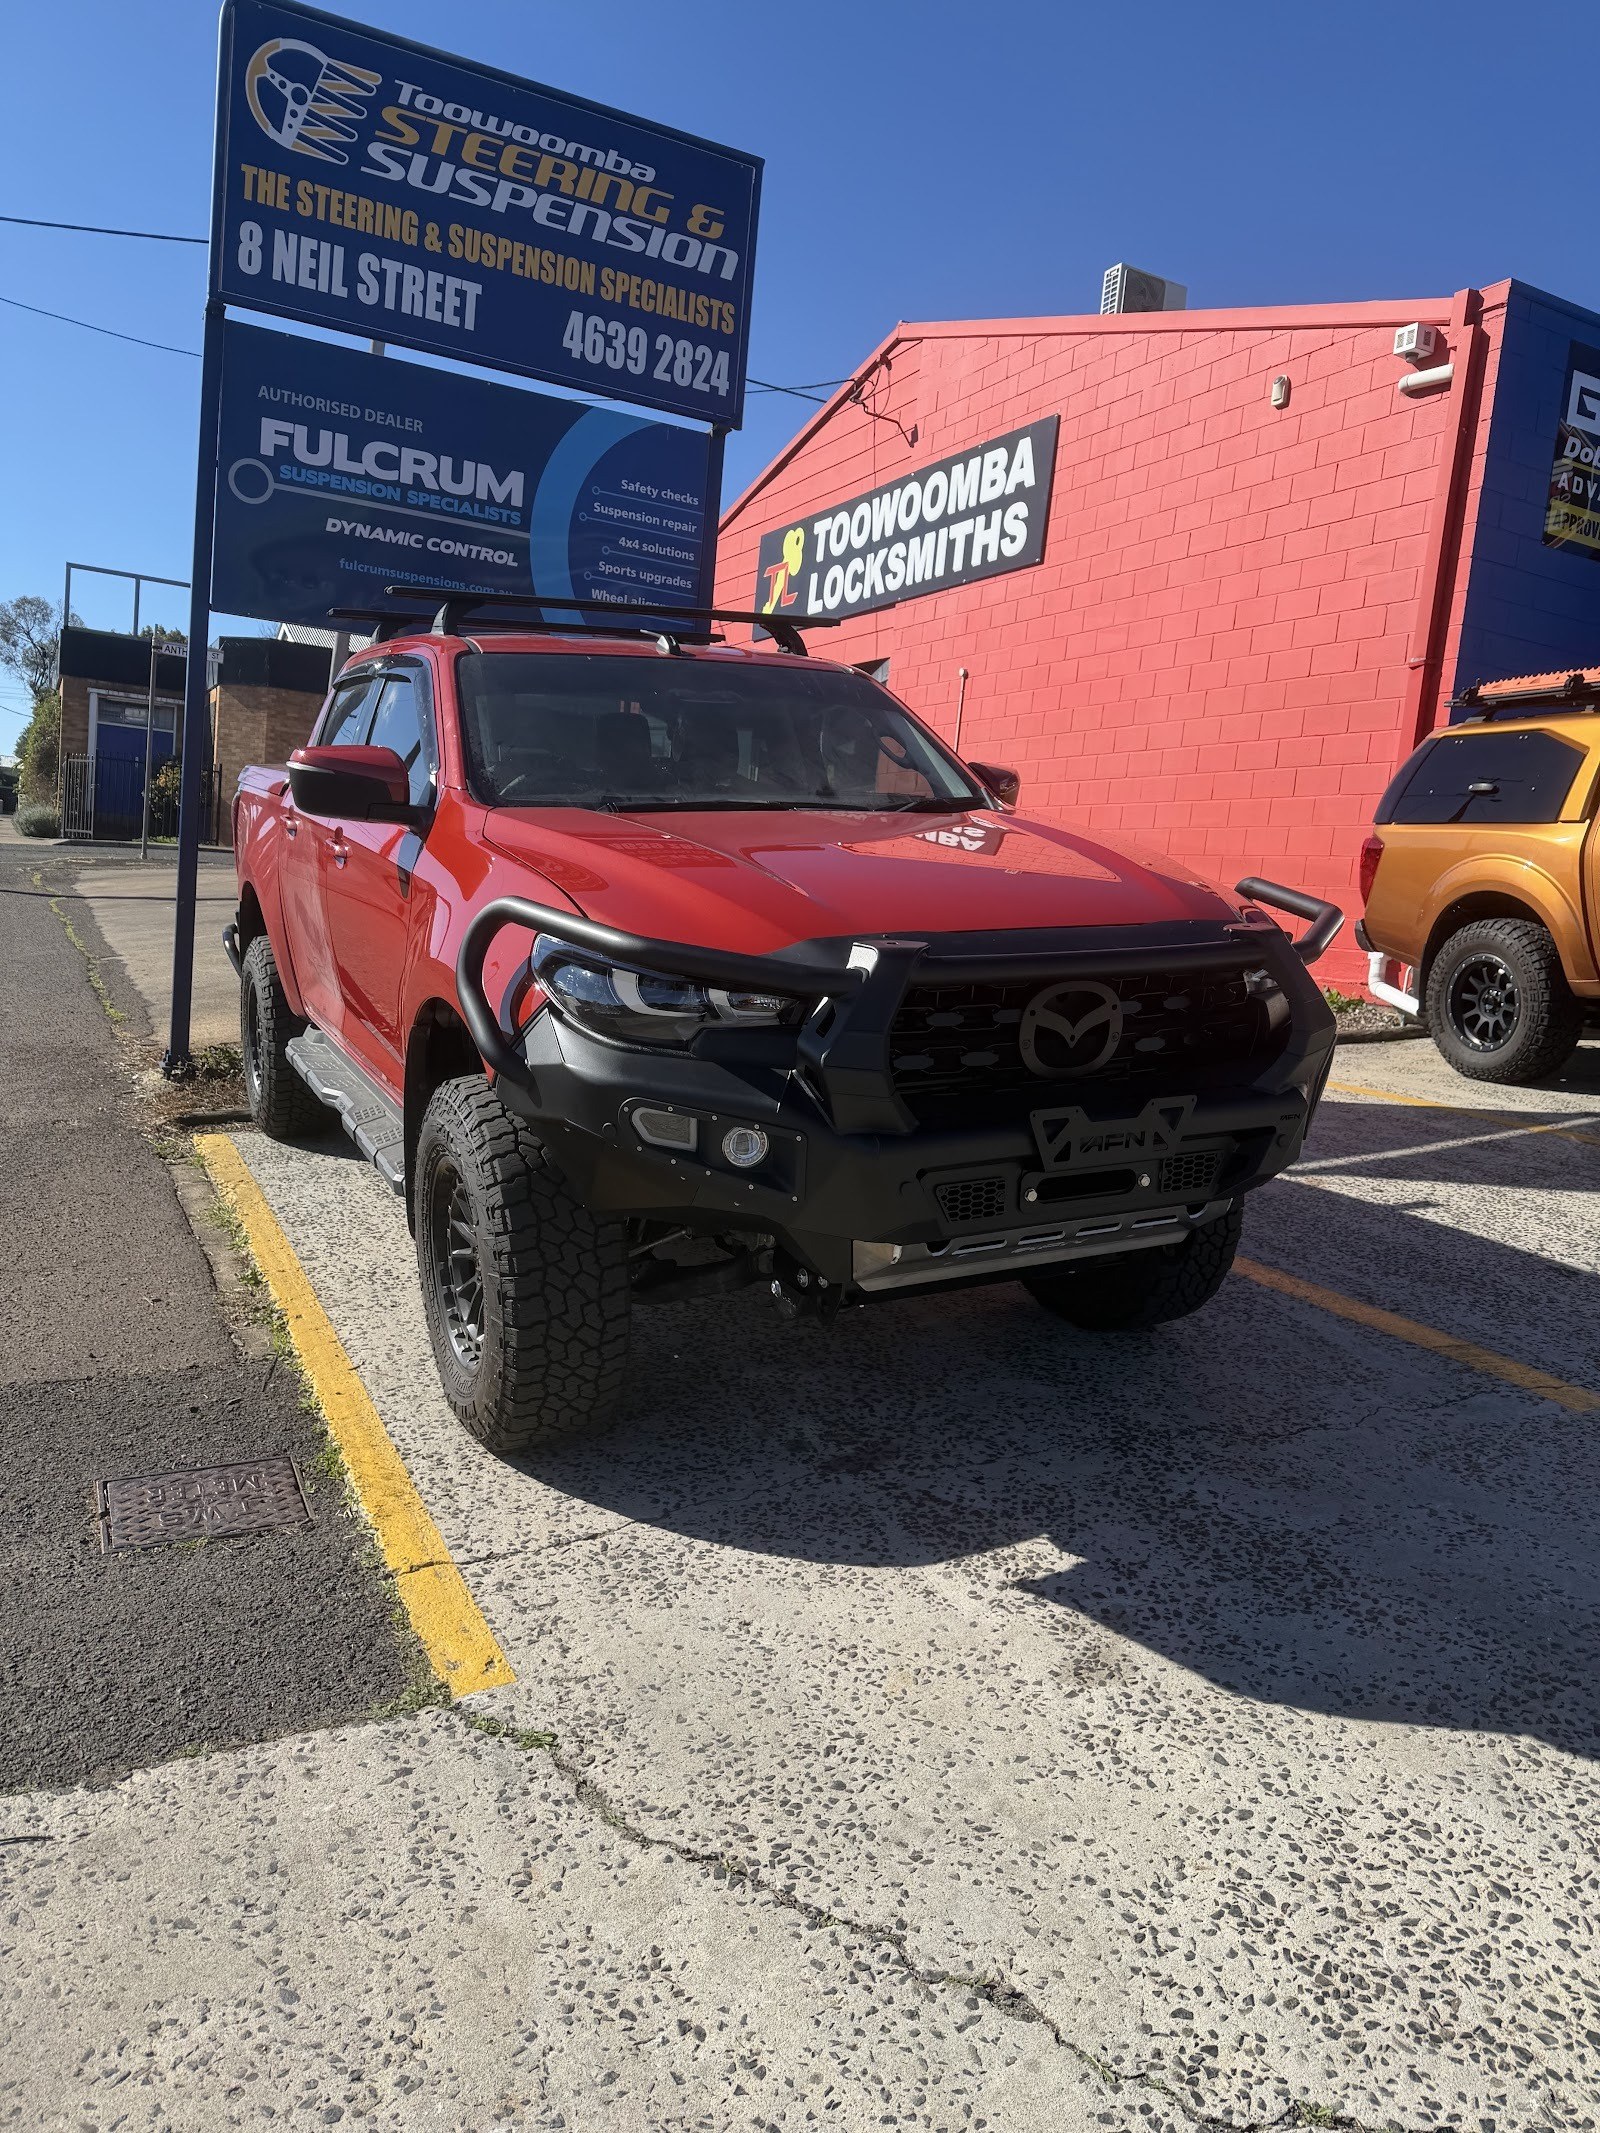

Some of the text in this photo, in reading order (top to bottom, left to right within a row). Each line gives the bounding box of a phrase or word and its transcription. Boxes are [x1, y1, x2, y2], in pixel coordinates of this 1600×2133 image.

[375, 106, 725, 240] STEERING &
[394, 79, 656, 183] Toowoomba
[241, 163, 735, 335] THE STEERING & SUSPENSION SPECIALISTS
[360, 143, 739, 281] SUSPENSION
[237, 220, 483, 331] 8 NEIL STREET
[562, 310, 731, 397] 4639 2824
[257, 384, 423, 433] AUTHORISED DEALER
[260, 416, 524, 508] FULCRUM
[279, 464, 522, 525] SUSPENSION SPECIALISTS
[621, 479, 699, 505] Safety checks
[813, 436, 1036, 563] TOOWOOMBA
[325, 517, 519, 567] DYNAMIC CONTROL
[593, 501, 697, 534] Suspension repair
[618, 535, 695, 562] 4x4 solutions
[806, 501, 1029, 616] LOCKSMITHS
[591, 588, 627, 604] Wheel
[599, 561, 692, 589] Sports upgrades
